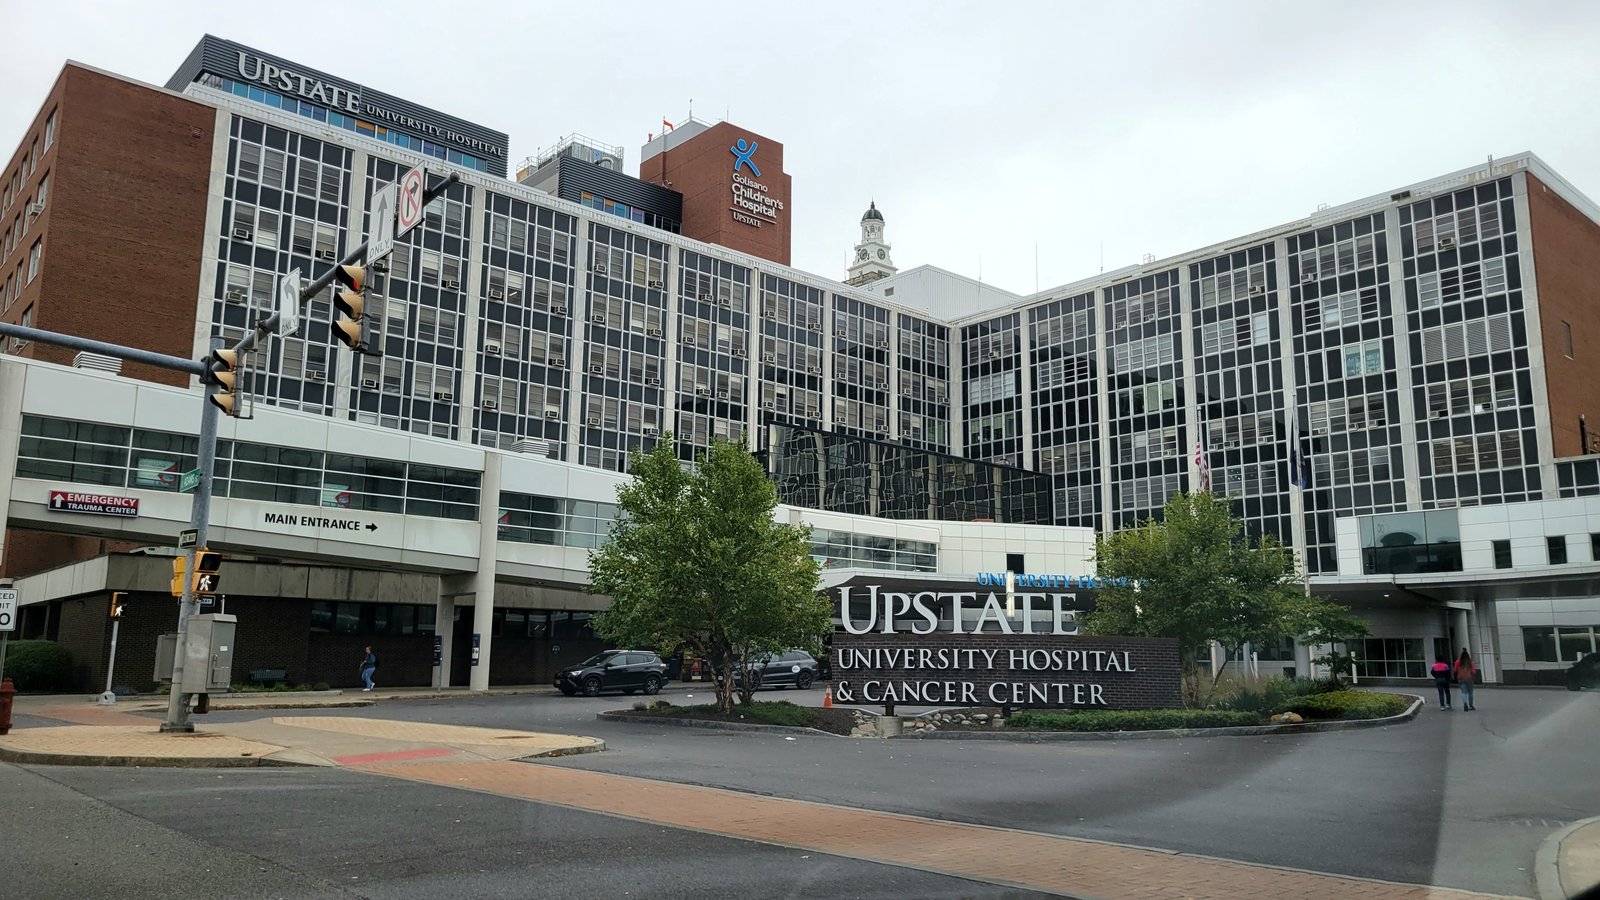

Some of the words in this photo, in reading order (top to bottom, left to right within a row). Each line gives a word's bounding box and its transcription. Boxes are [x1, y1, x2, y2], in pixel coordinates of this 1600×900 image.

[237, 50, 361, 114] UPSTATE
[366, 104, 442, 137] UNIVERSITY
[445, 130, 502, 156] HOSPITAL
[732, 172, 768, 192] Golisano
[731, 183, 784, 210] Children's
[733, 194, 777, 218] Hospital
[733, 212, 762, 228] UPSTATE
[369, 238, 390, 259] ONLY
[67, 493, 137, 507] EMERGENCY
[68, 502, 103, 513] TRAUMA
[105, 506, 136, 515] CENTER
[265, 513, 297, 526] MAIN
[301, 516, 360, 531] ENTRANCE
[837, 585, 1079, 635] UPSTATE
[838, 648, 998, 670] UNIVERSITY
[1008, 650, 1136, 672] HOSPITAL
[836, 680, 853, 701] &
[863, 681, 980, 703] CANCER
[988, 682, 1109, 705] CENTER
